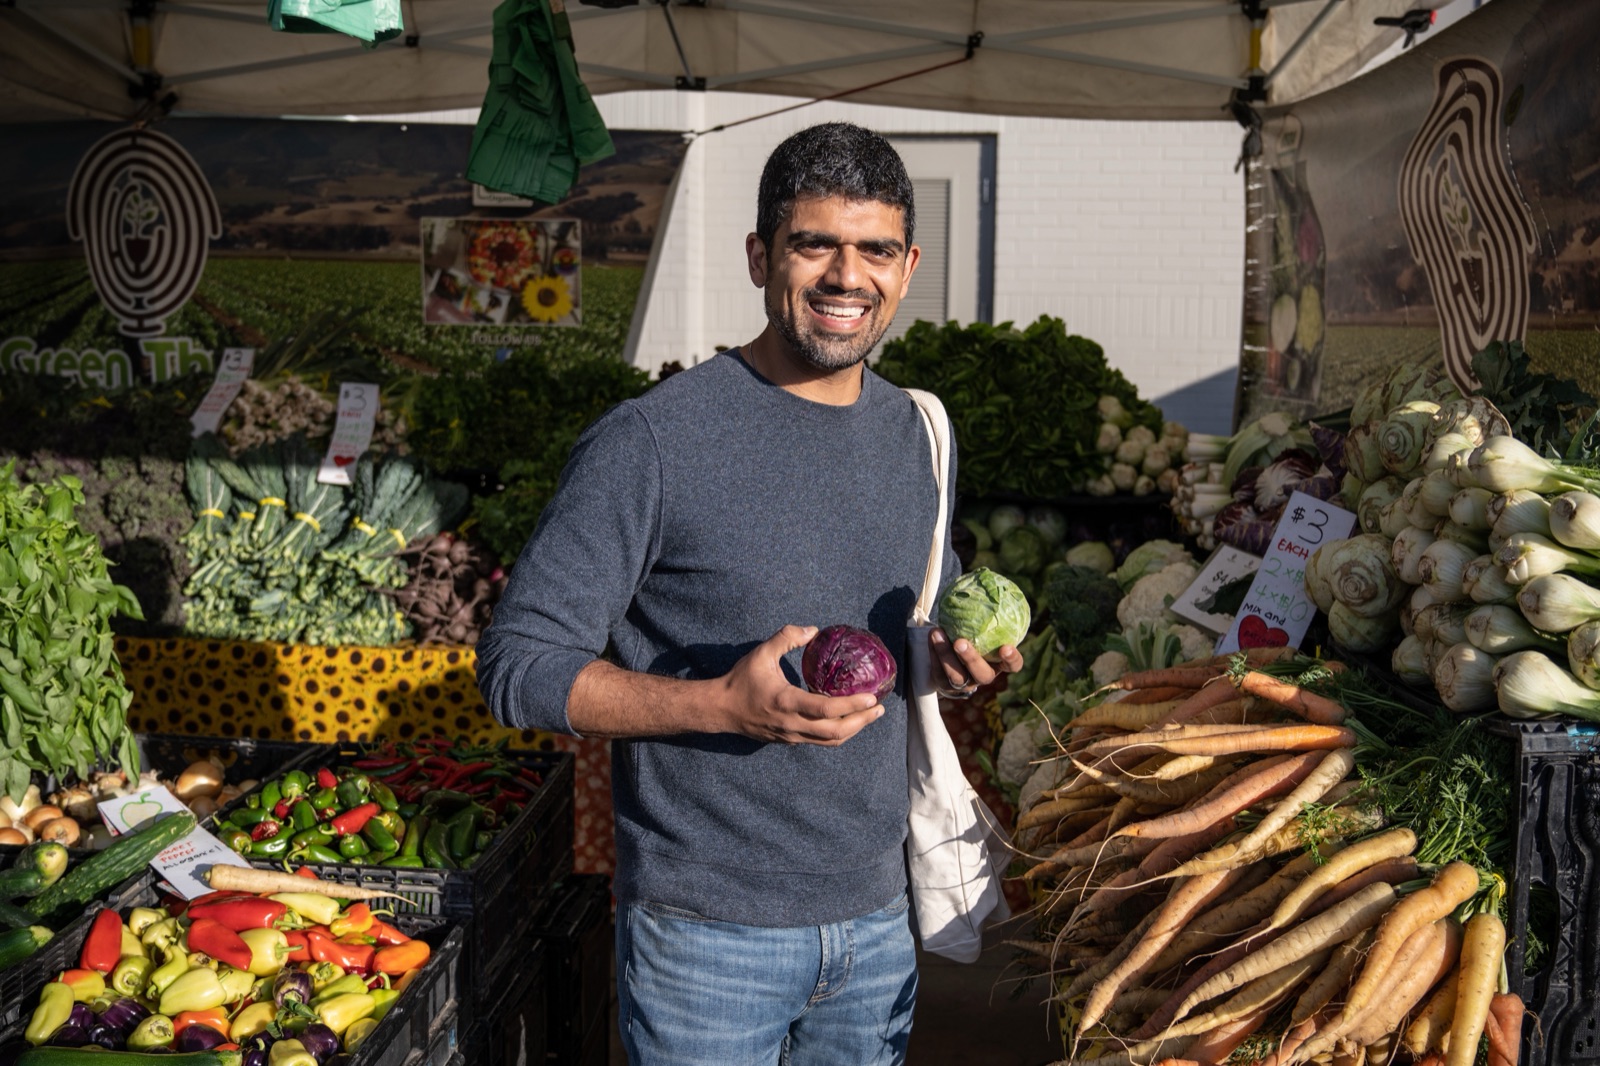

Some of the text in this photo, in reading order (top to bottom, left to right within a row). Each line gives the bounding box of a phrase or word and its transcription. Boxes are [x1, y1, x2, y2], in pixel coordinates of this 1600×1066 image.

[0, 338, 213, 388] Green Th
[1291, 506, 1329, 544] $3
[1277, 538, 1309, 560] EACH
[1264, 612, 1286, 626] and
